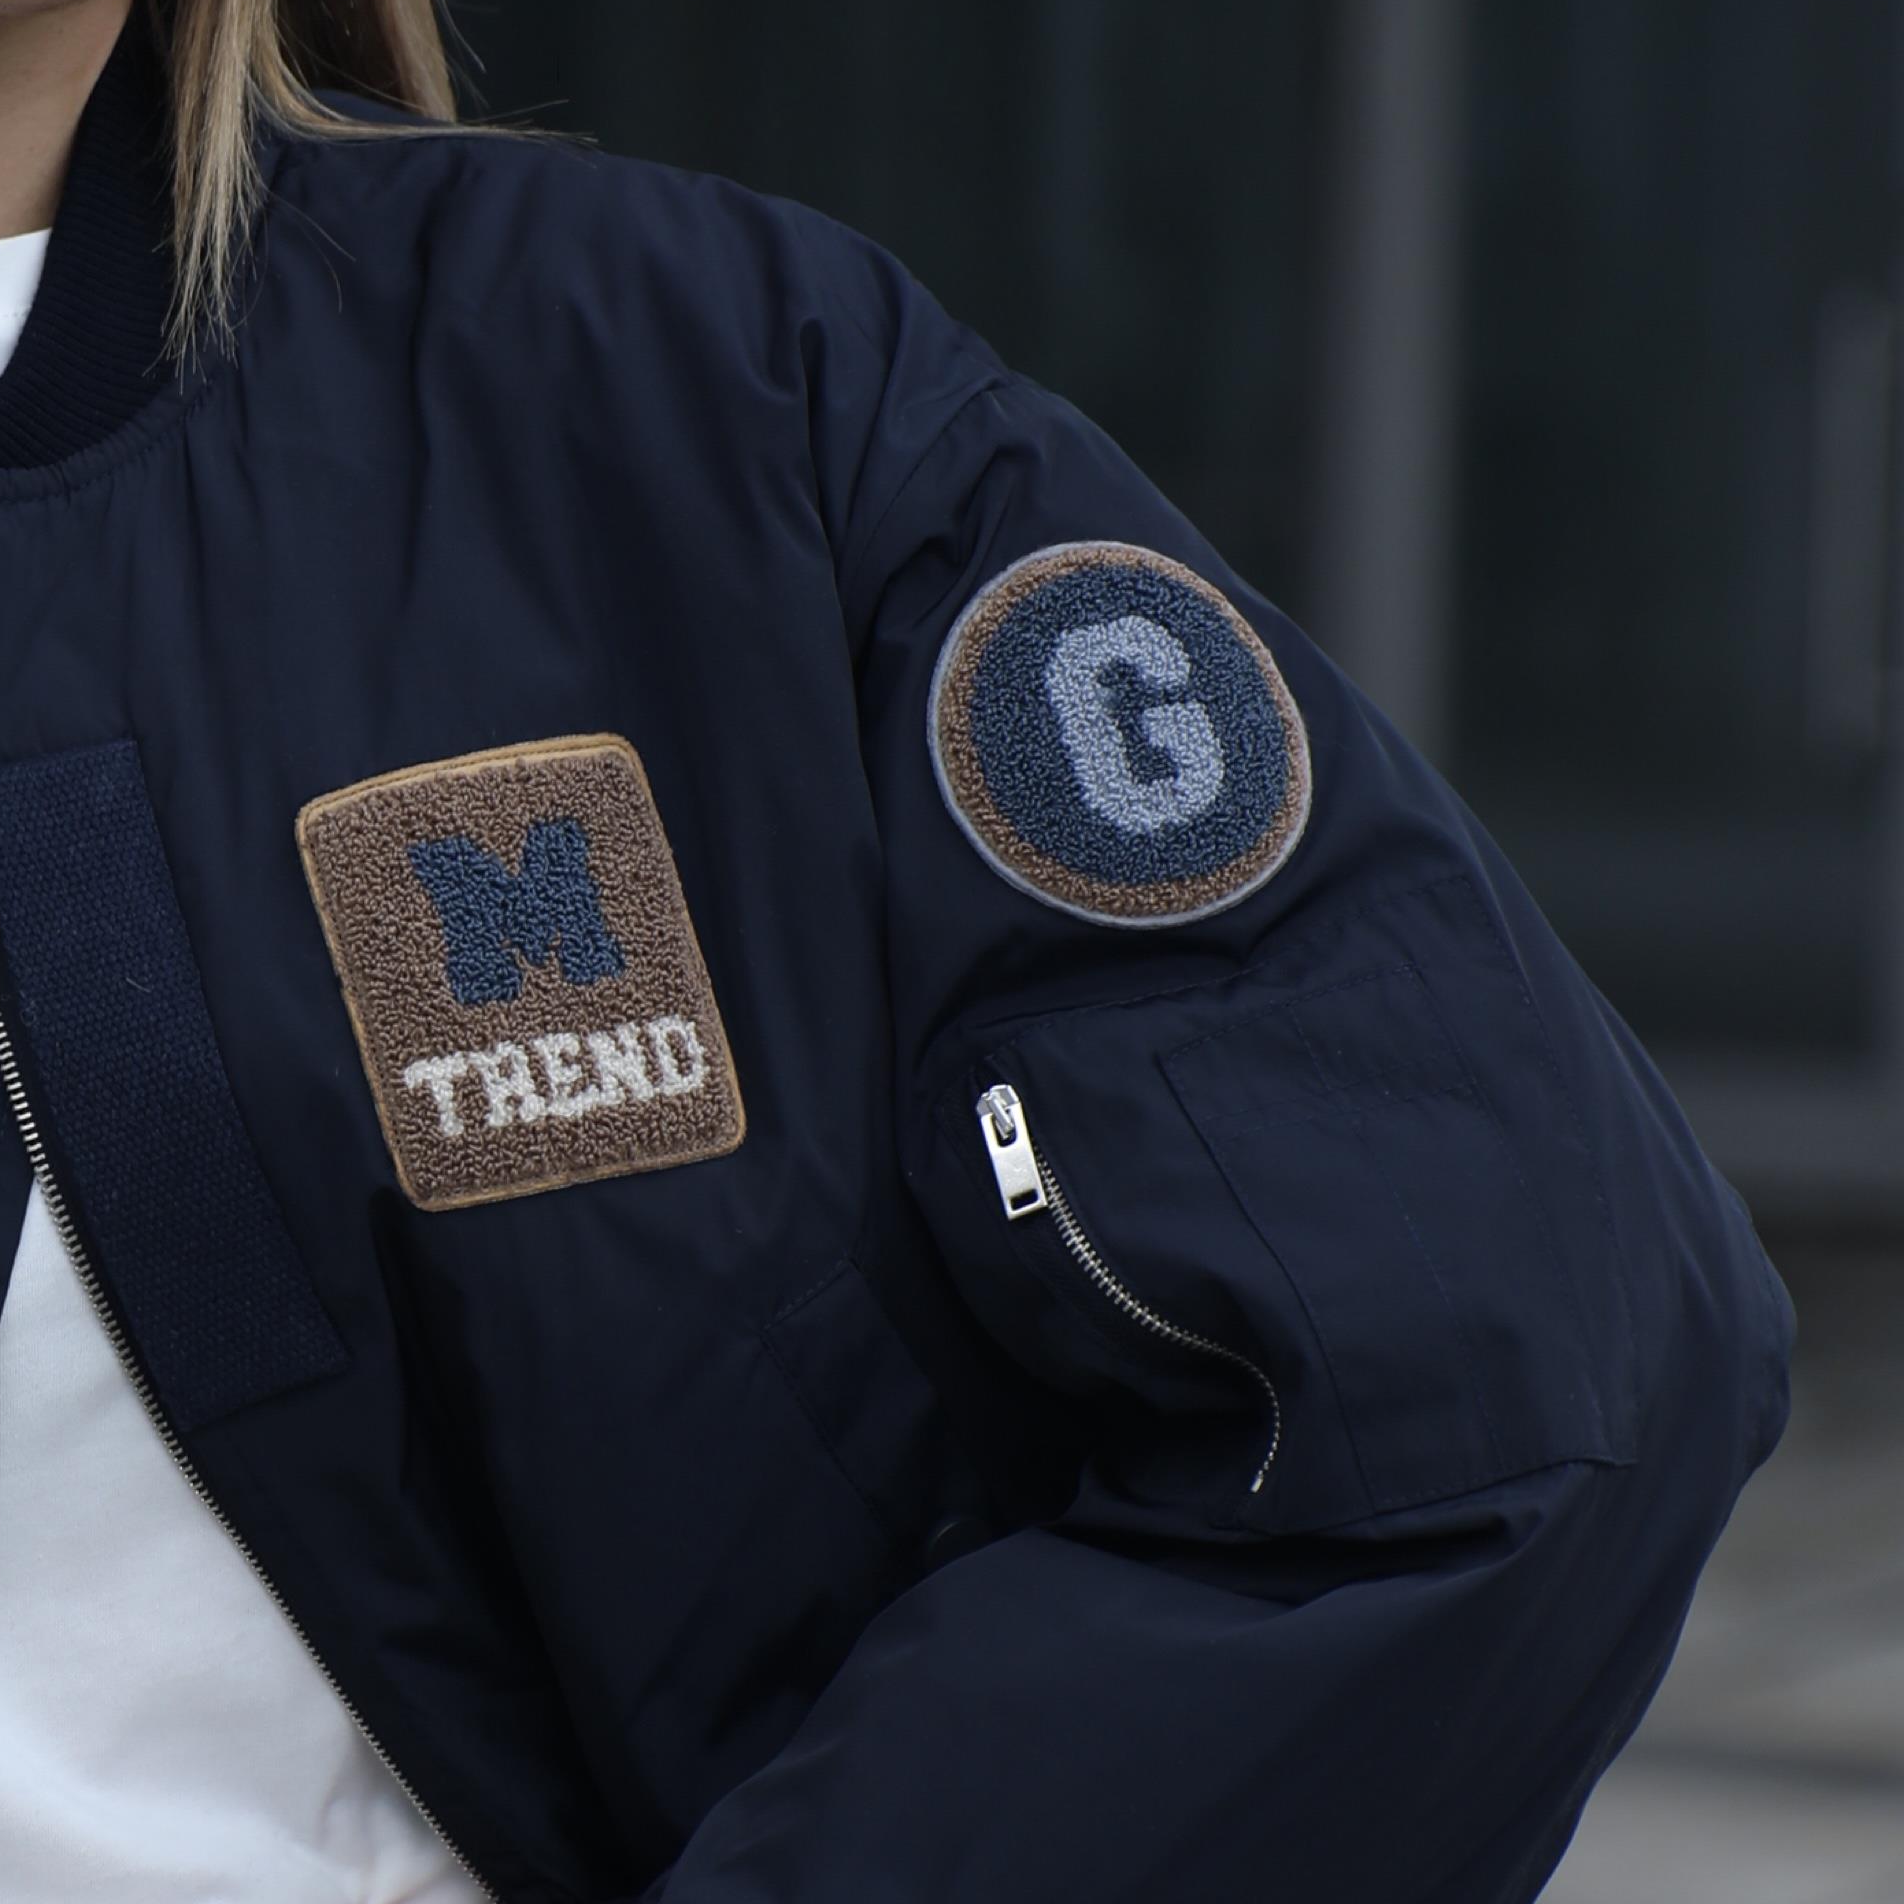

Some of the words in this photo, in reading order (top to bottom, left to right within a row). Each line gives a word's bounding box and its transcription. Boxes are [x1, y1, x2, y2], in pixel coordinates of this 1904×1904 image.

[1045, 616, 1226, 834] G
[407, 816, 626, 1005] M
[405, 1014, 711, 1137] TREND
